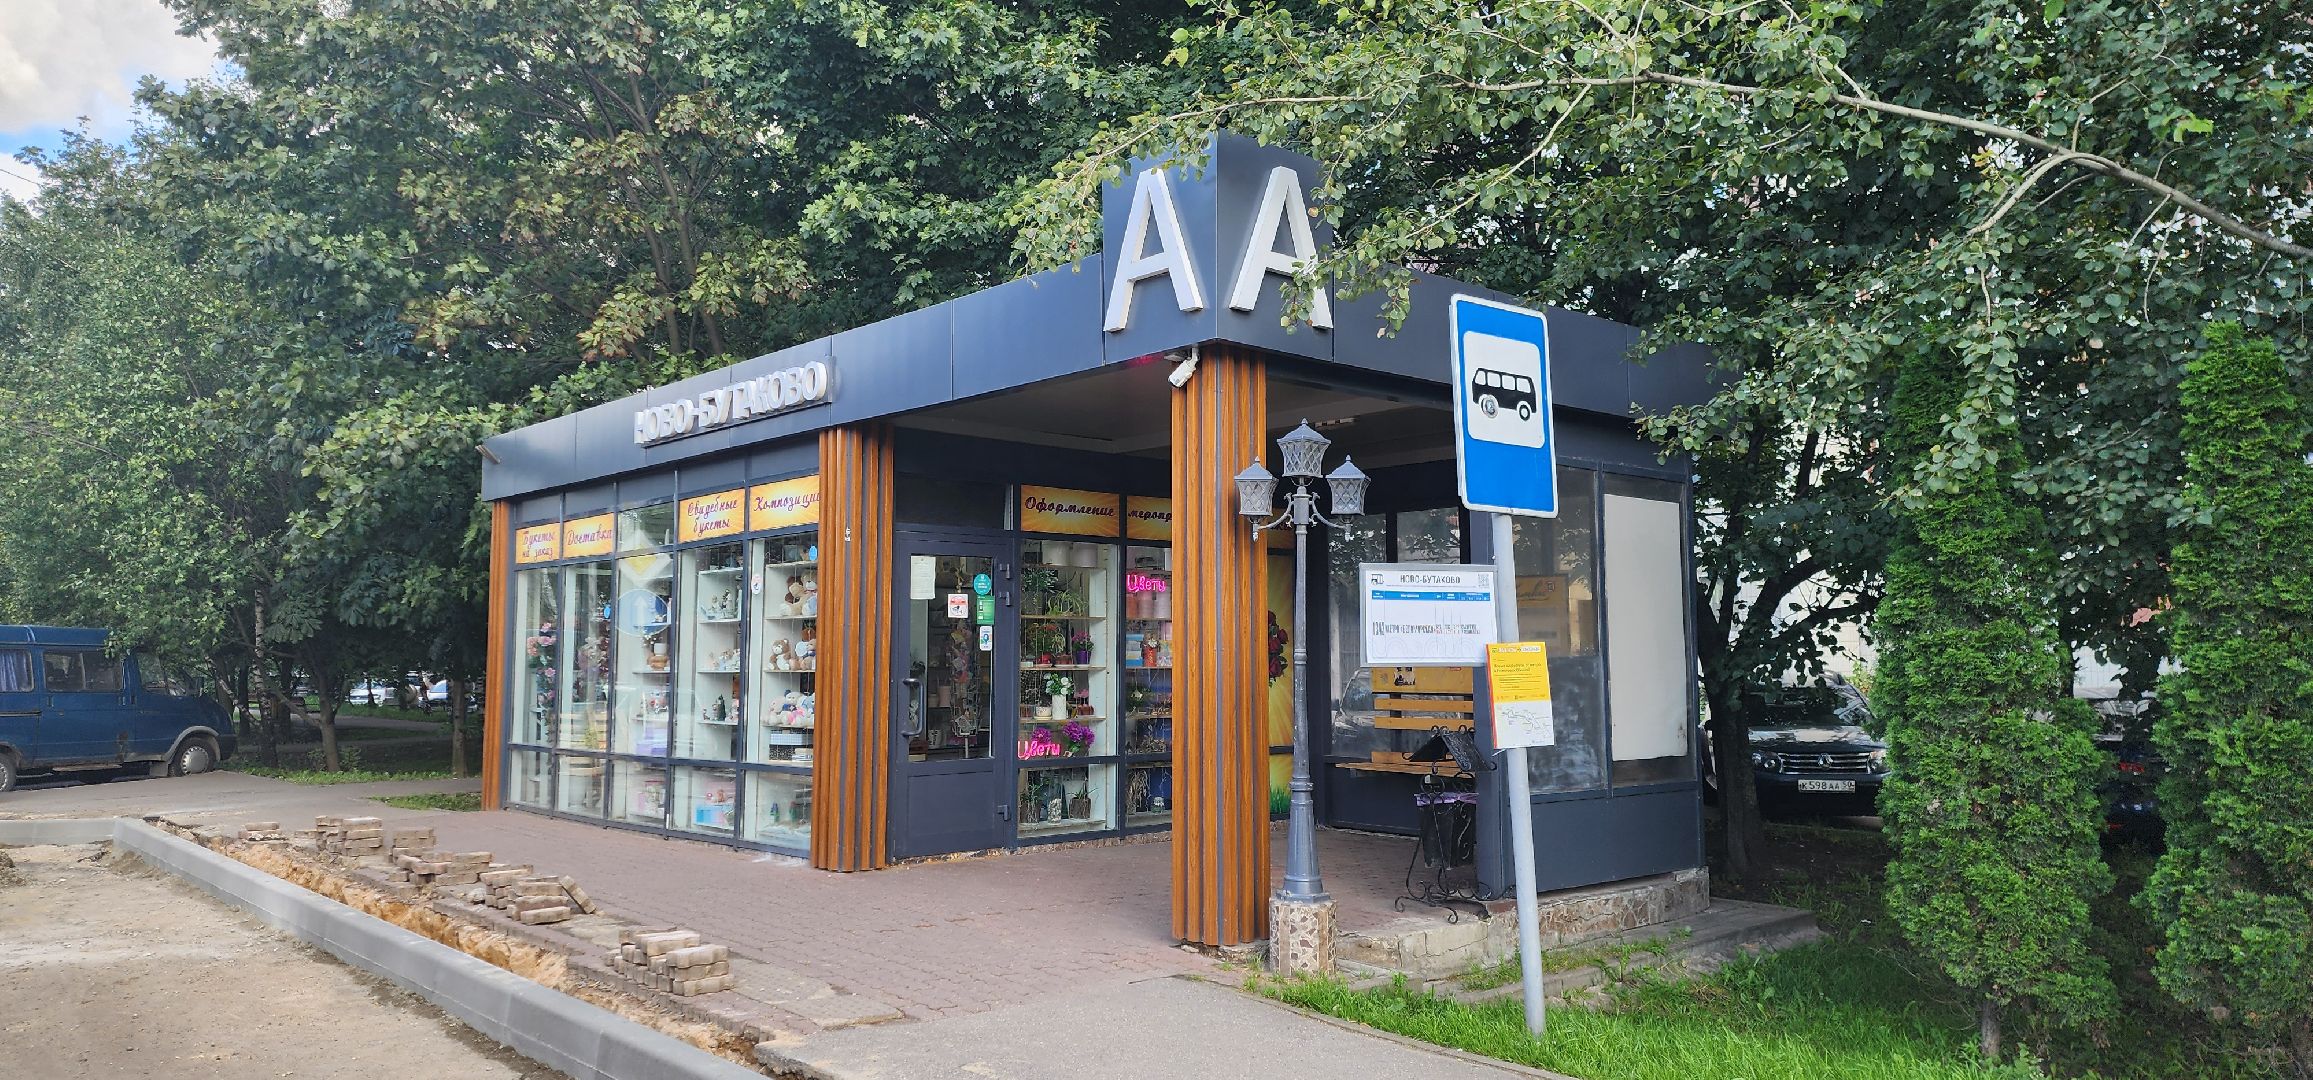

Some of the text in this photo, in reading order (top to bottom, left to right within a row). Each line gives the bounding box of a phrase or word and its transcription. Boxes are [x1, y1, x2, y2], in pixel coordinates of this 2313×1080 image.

[1103, 168, 1204, 333] А
[1229, 166, 1334, 330] А
[634, 360, 828, 445] НОВО-БУТАКОВО
[1024, 496, 1115, 518] Оформление
[567, 524, 612, 546] Доставка
[693, 517, 730, 538] букеты
[522, 530, 555, 549] Букеты
[533, 547, 554, 562] заказ
[1126, 573, 1167, 593] Цветы
[1400, 574, 1461, 584] НОВО-БУТАКОВО
